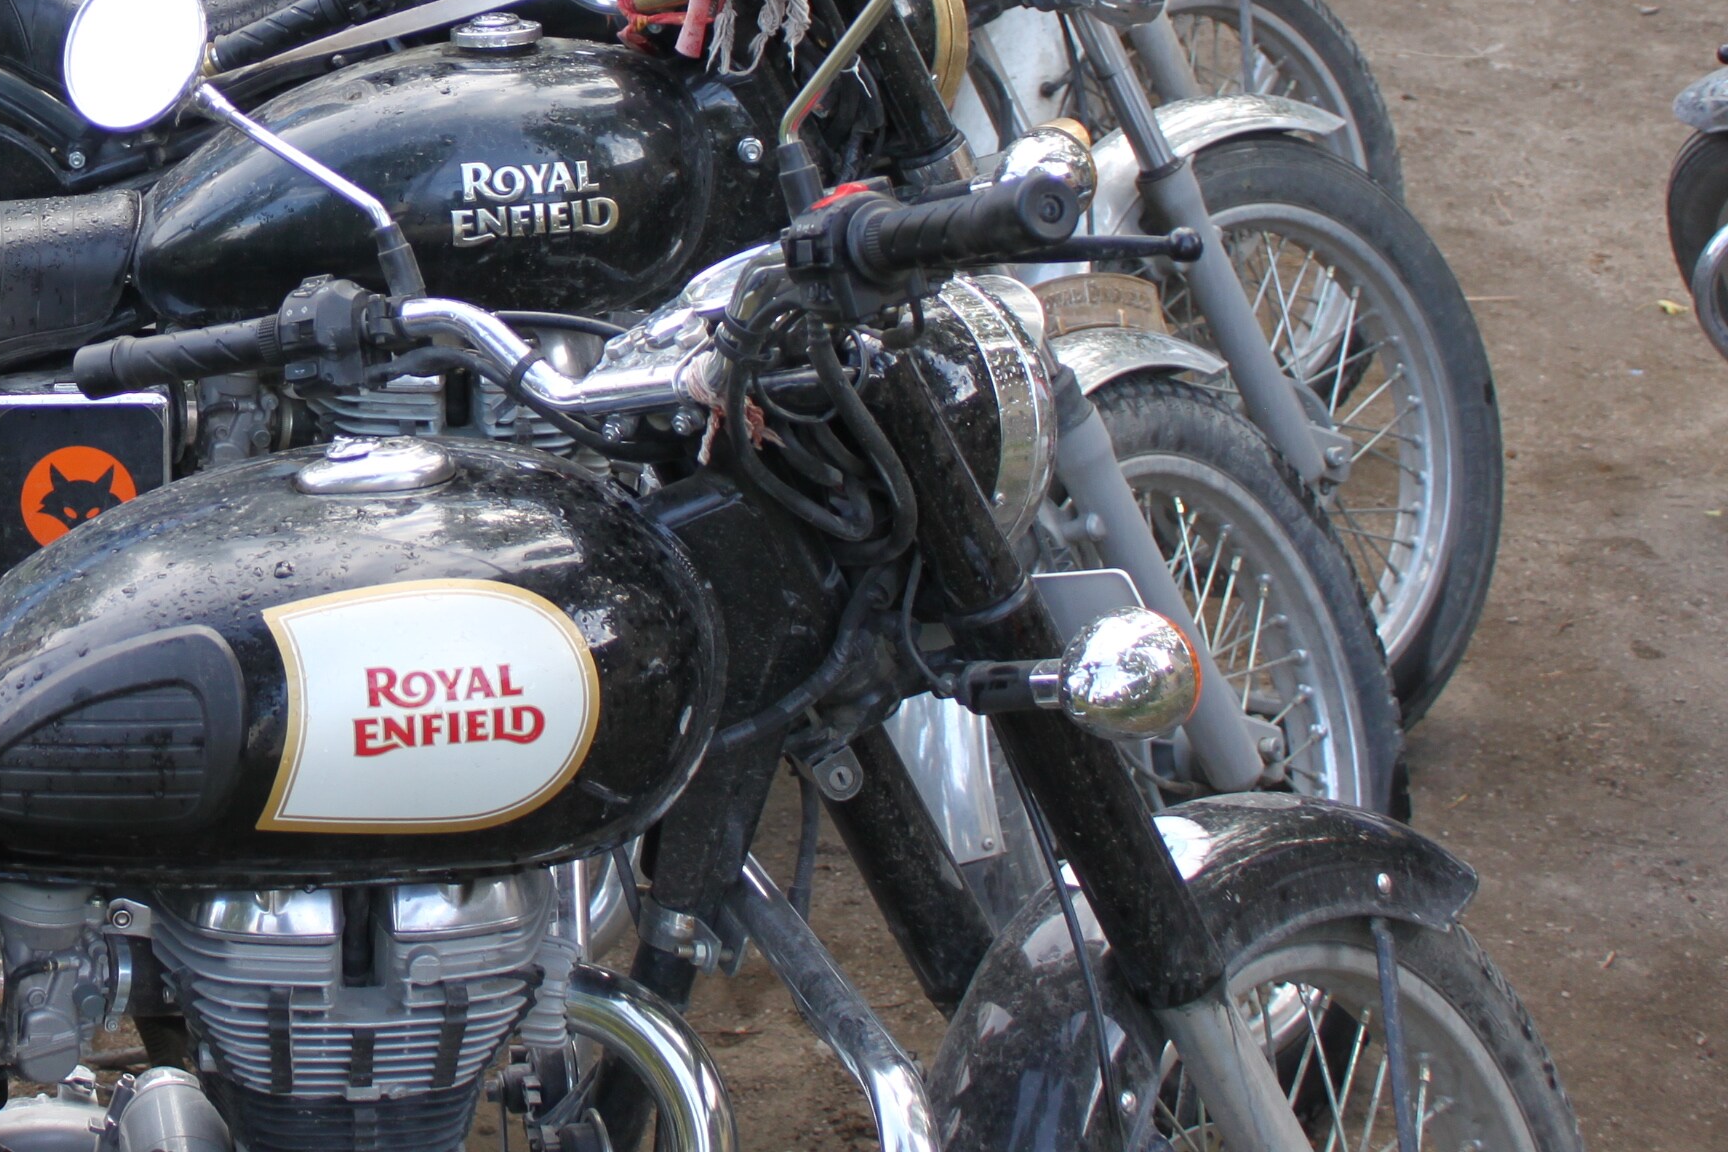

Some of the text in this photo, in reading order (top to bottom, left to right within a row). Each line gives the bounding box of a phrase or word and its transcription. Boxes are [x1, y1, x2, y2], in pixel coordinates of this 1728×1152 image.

[460, 160, 600, 203] ROYAL
[451, 196, 619, 248] ENFIELD
[365, 663, 524, 709] ROYAL
[352, 705, 545, 757] ENFIELD
